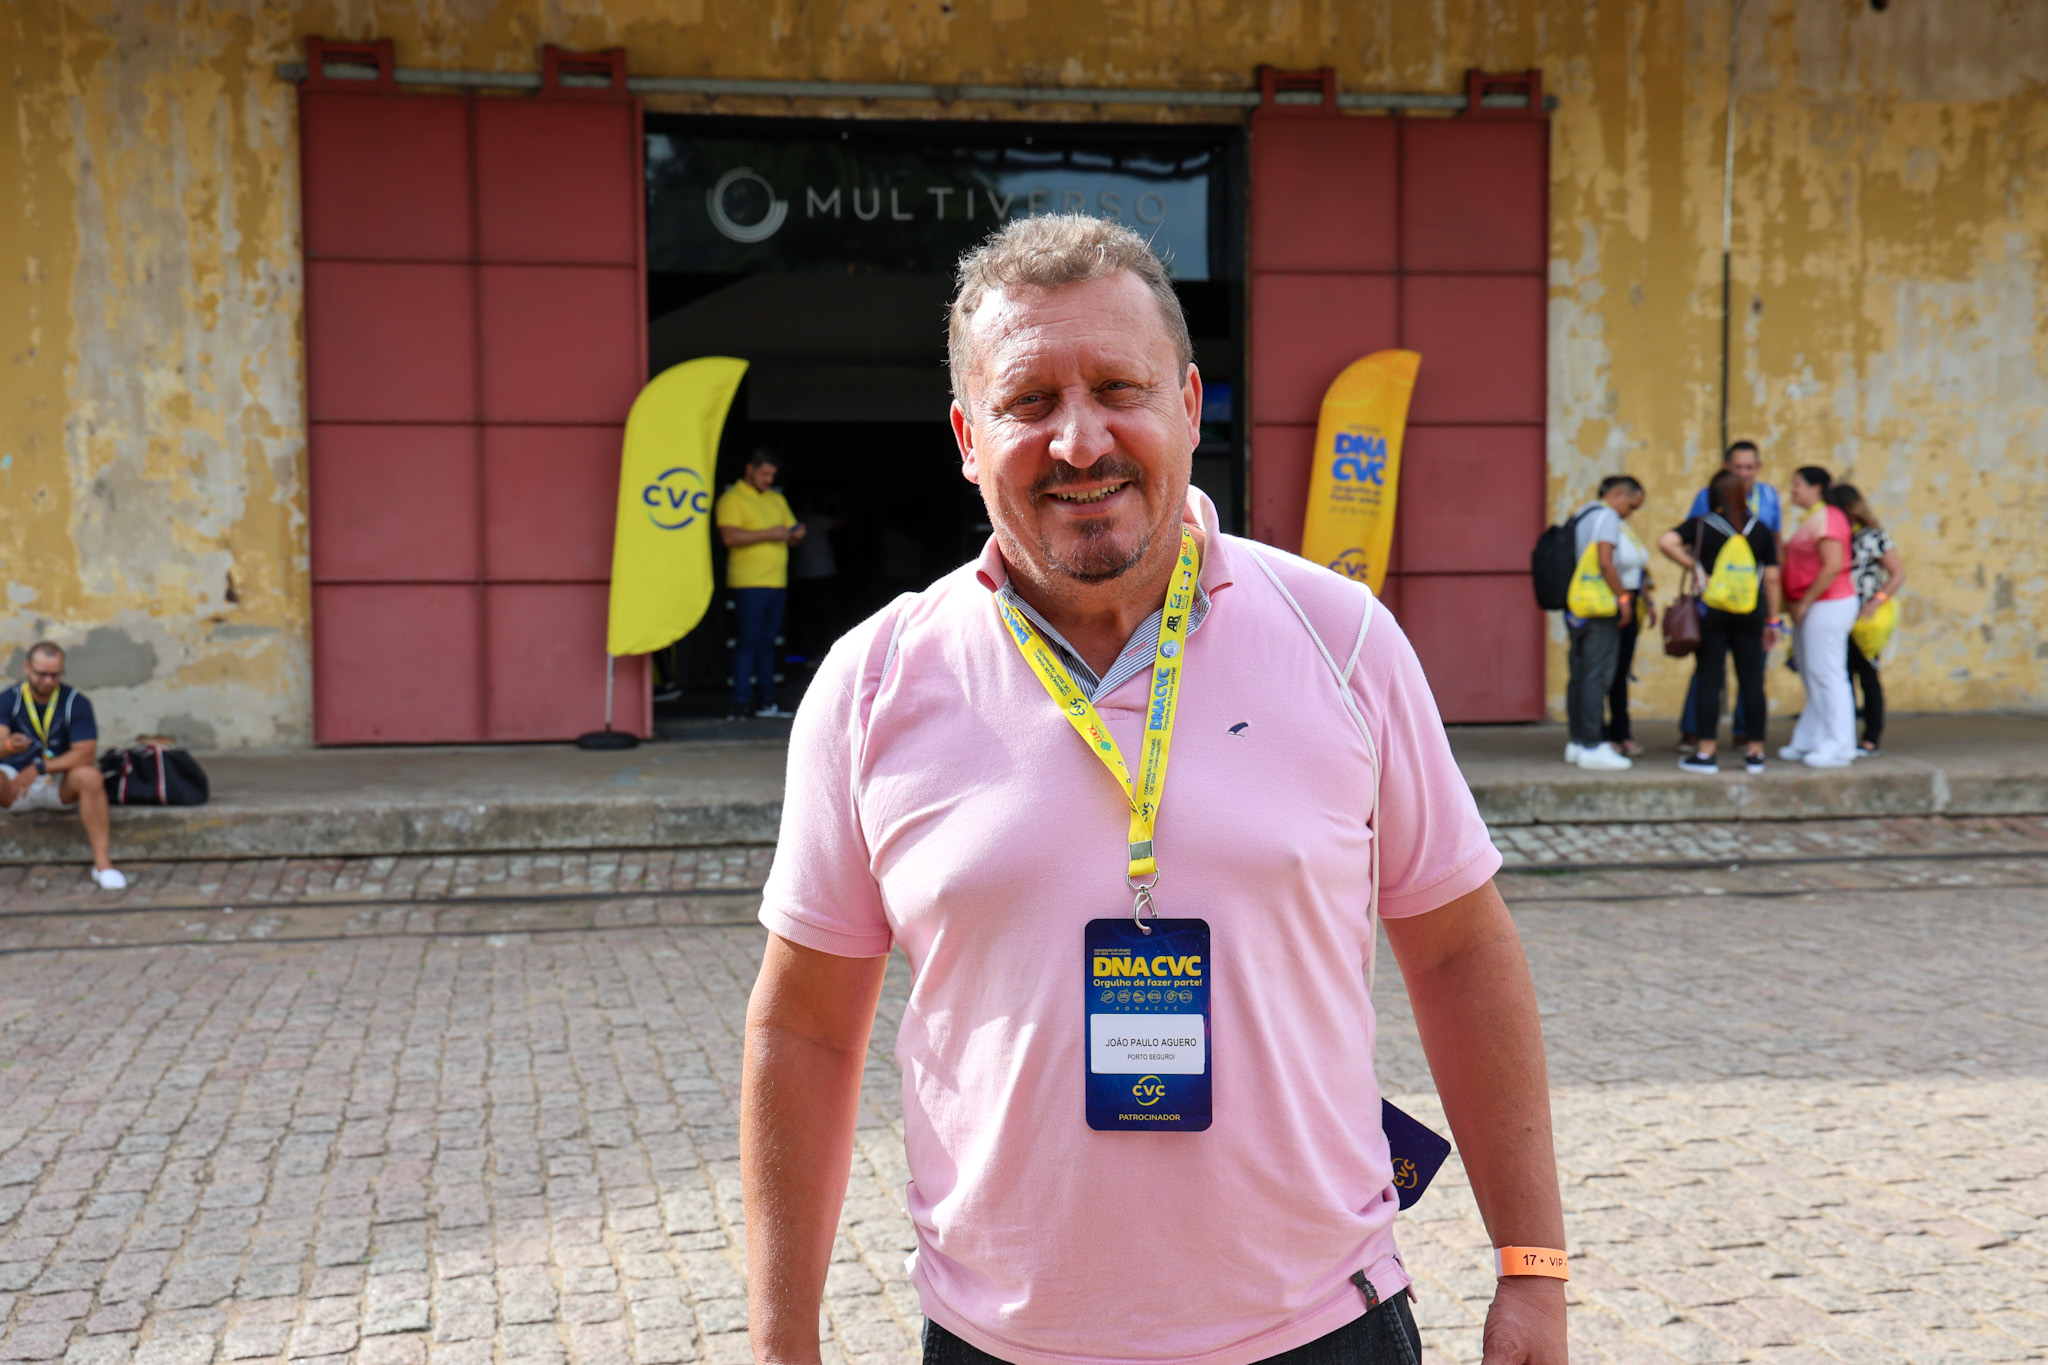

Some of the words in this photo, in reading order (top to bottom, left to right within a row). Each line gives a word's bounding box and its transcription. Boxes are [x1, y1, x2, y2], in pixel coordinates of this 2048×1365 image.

[1334, 432, 1388, 460] DNA
[1332, 457, 1386, 486] CVC
[643, 485, 709, 513] CVC
[1070, 698, 1085, 715] CVC
[1087, 725, 1103, 743] LUCK
[1093, 979, 1132, 988] Orgulho
[1174, 979, 1202, 988] parte!
[1105, 1037, 1129, 1047] JOÃO
[1131, 1038, 1159, 1047] PAULO
[1161, 1038, 1197, 1047] AGUERO
[1132, 1085, 1166, 1096] CVC
[1394, 1159, 1415, 1187] CVC
[1523, 1254, 1537, 1266] 17
[1549, 1256, 1563, 1267] VIP
